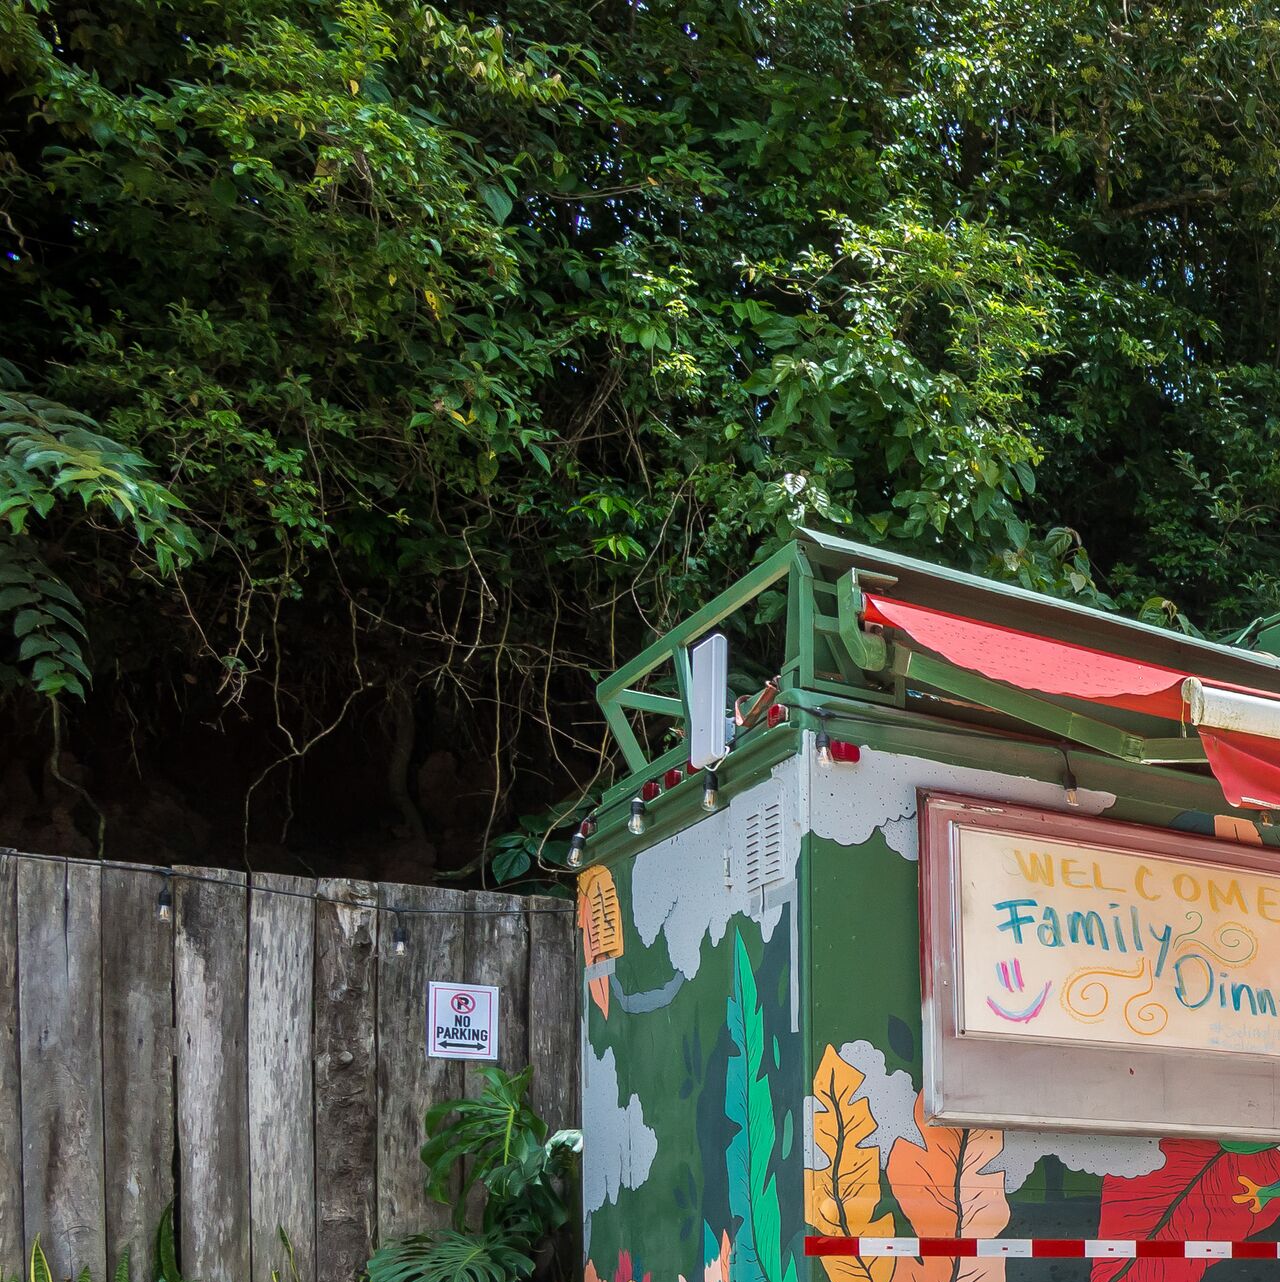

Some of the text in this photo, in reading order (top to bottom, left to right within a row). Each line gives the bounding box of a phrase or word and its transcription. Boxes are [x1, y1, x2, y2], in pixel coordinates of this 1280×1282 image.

[992, 898, 1172, 978] Family
[454, 1014, 471, 1027] NO
[436, 1026, 488, 1041] PARKING
